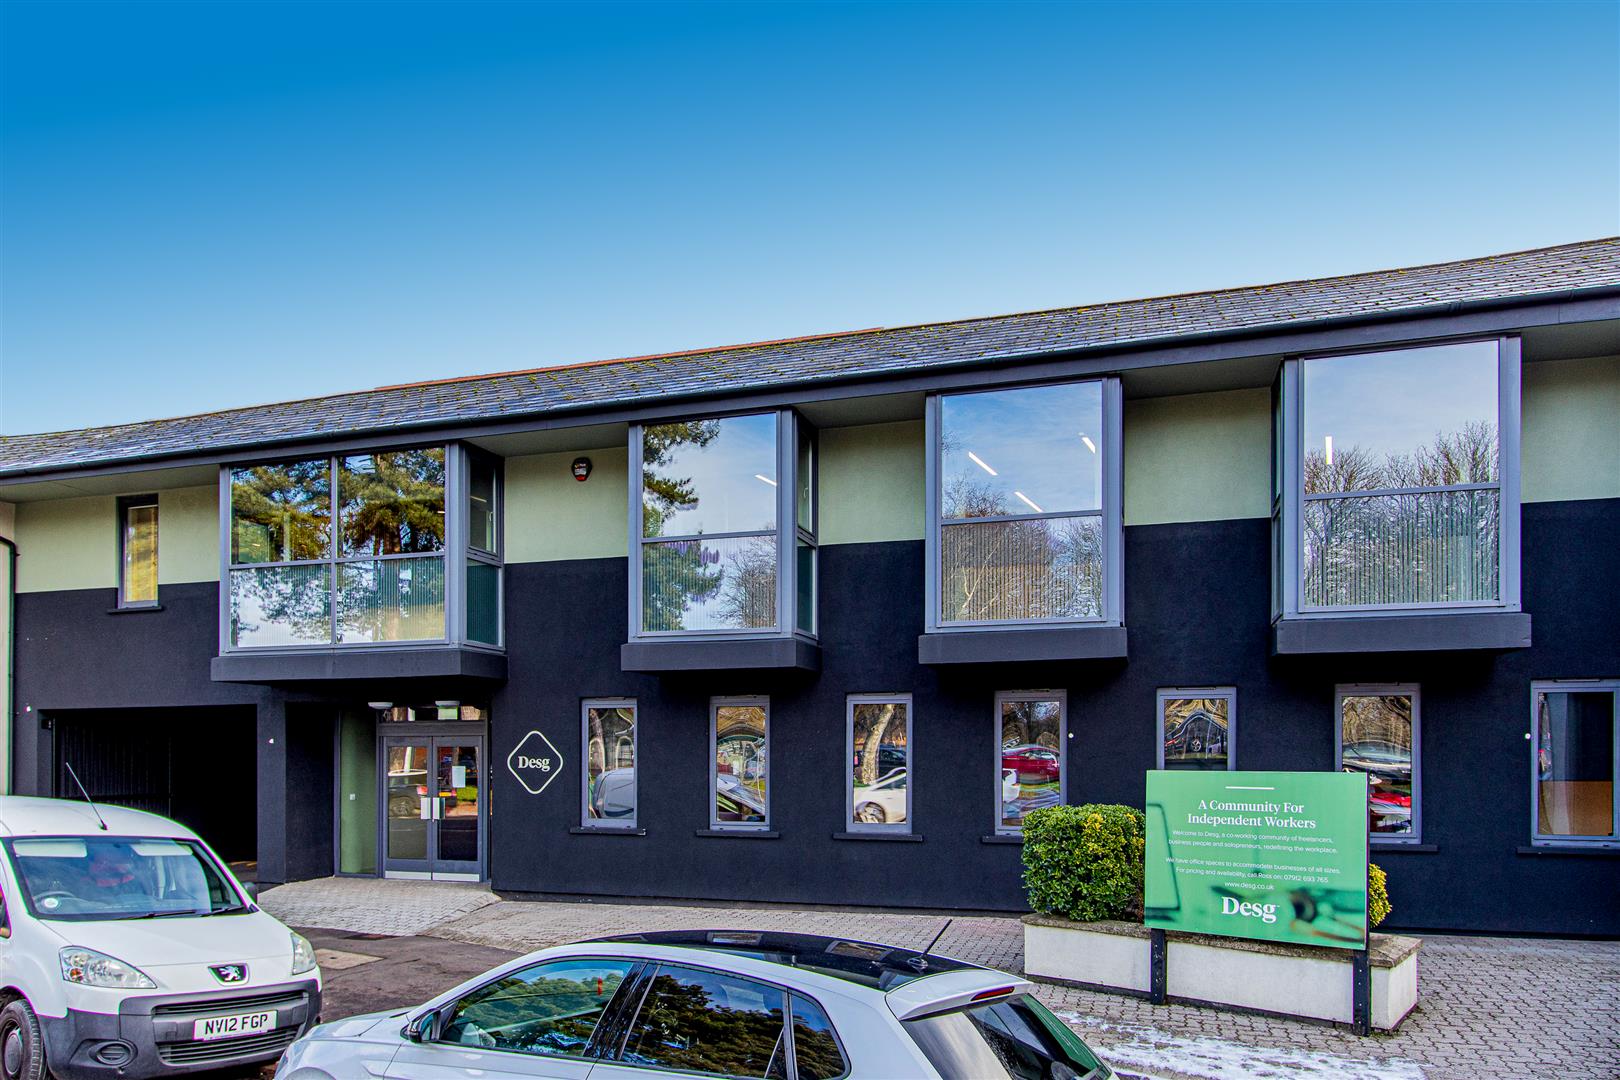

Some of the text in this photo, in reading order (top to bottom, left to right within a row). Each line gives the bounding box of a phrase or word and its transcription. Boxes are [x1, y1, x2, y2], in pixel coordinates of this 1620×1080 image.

[517, 755, 551, 772] Desg
[1197, 799, 1304, 814] A Community For
[1187, 813, 1316, 828] Independent Workers
[1258, 834, 1290, 842] community
[1192, 840, 1212, 848] people
[1263, 844, 1294, 852] redefining
[1273, 864, 1307, 872] businesses
[1224, 881, 1274, 890] www.desg.co.uk
[1220, 896, 1277, 924] Desg
[205, 1013, 268, 1034] NV12 FGP
